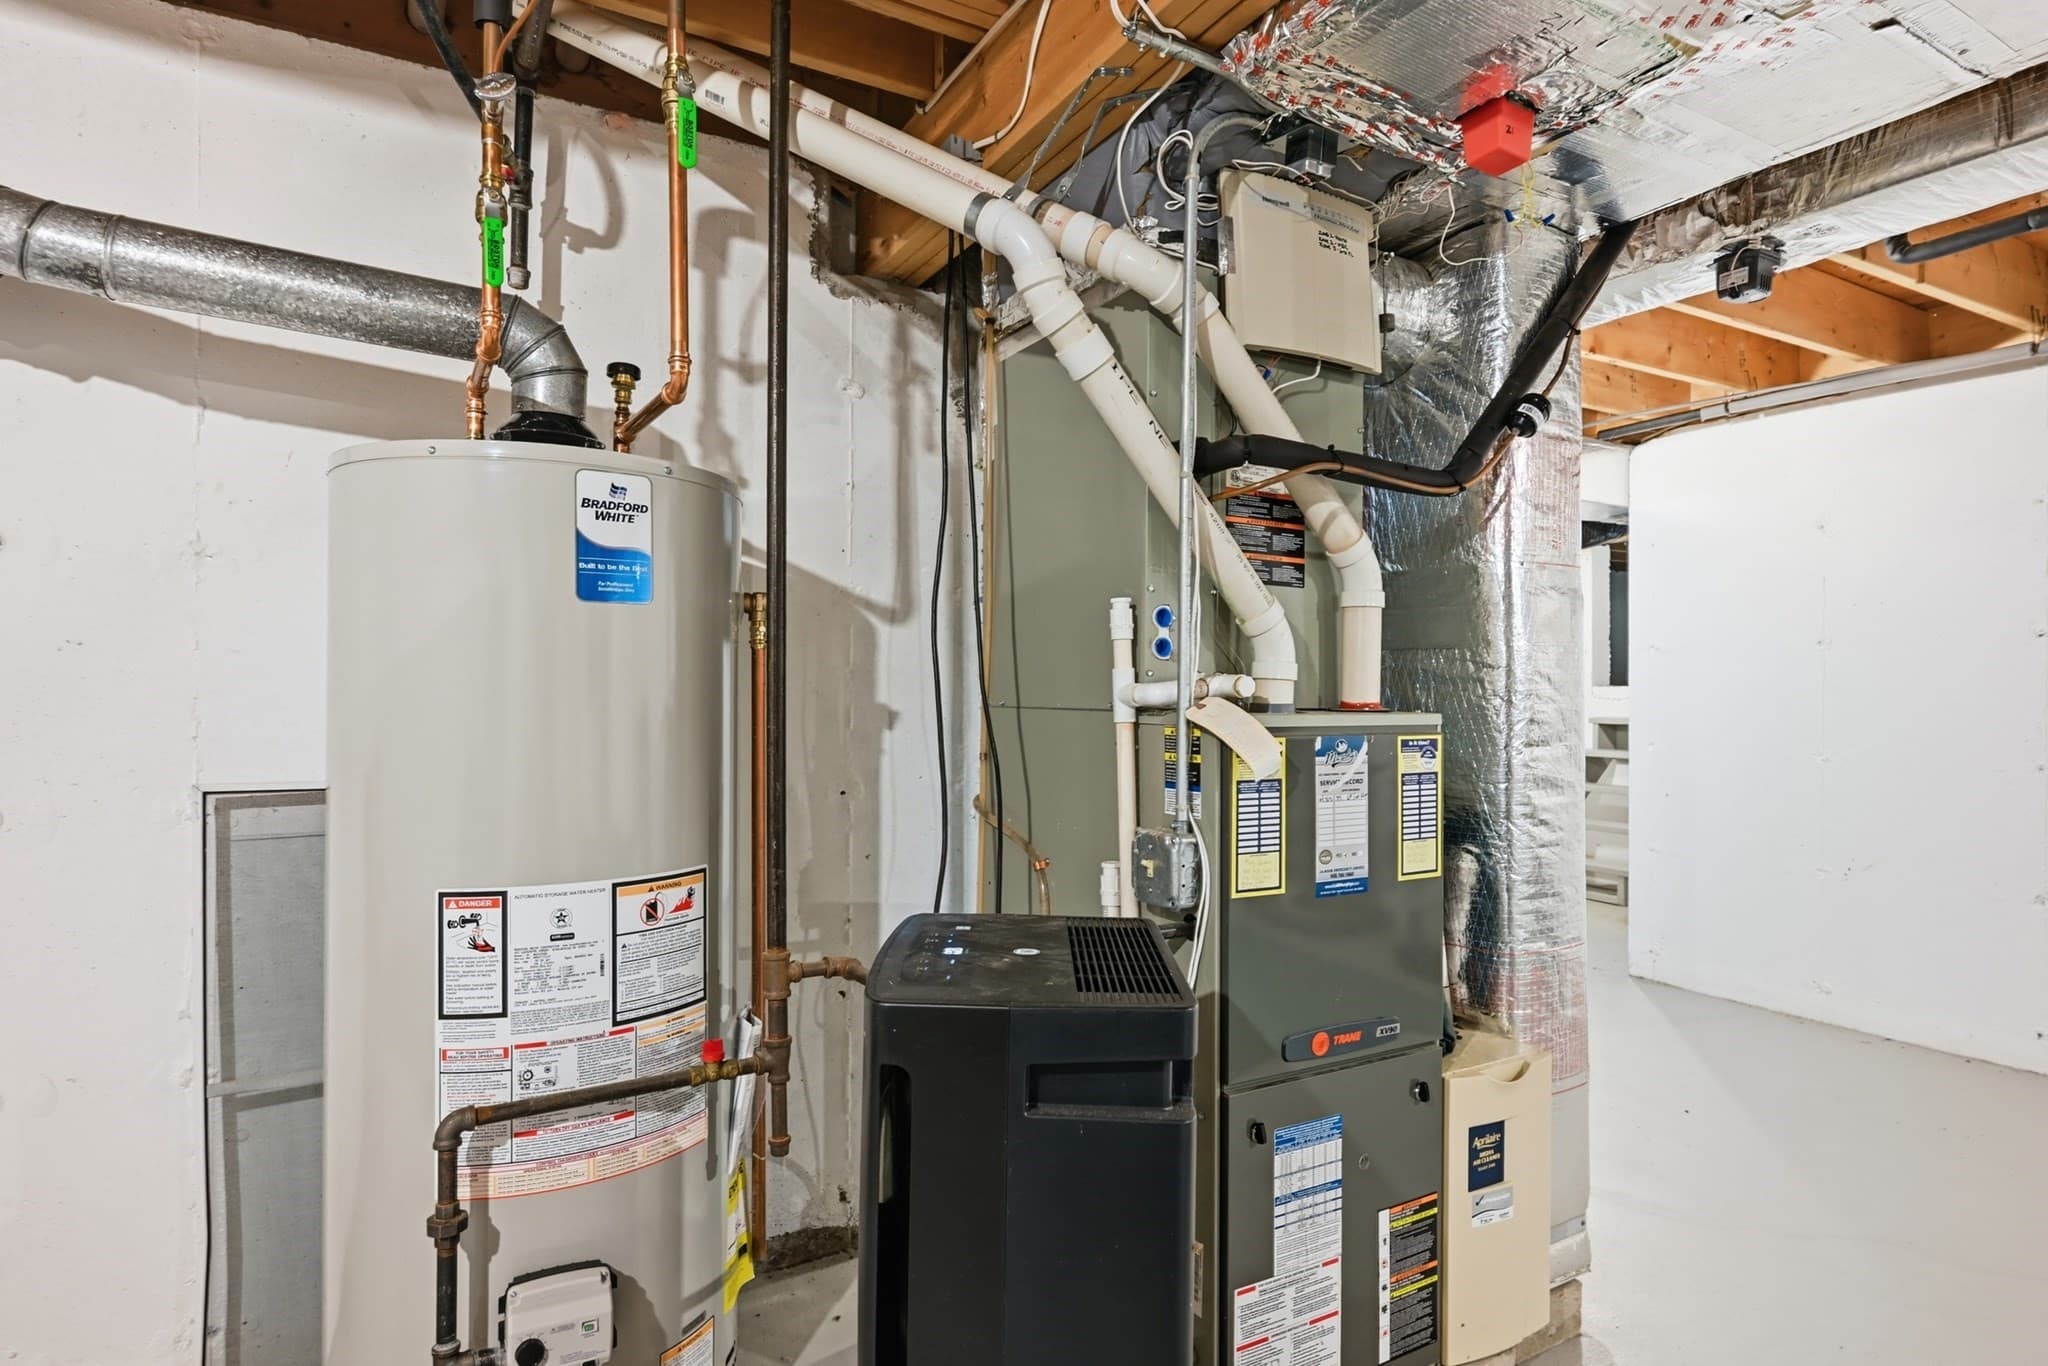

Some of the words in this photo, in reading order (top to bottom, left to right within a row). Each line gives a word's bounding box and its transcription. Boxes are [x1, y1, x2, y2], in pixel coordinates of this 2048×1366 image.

[581, 497, 649, 514] BRADFORD
[594, 510, 636, 524] WHITE
[655, 881, 682, 891] WARNING
[458, 900, 493, 908] DANGER
[1333, 1030, 1363, 1046] TRANE
[1472, 1132, 1501, 1149] Aprilaire
